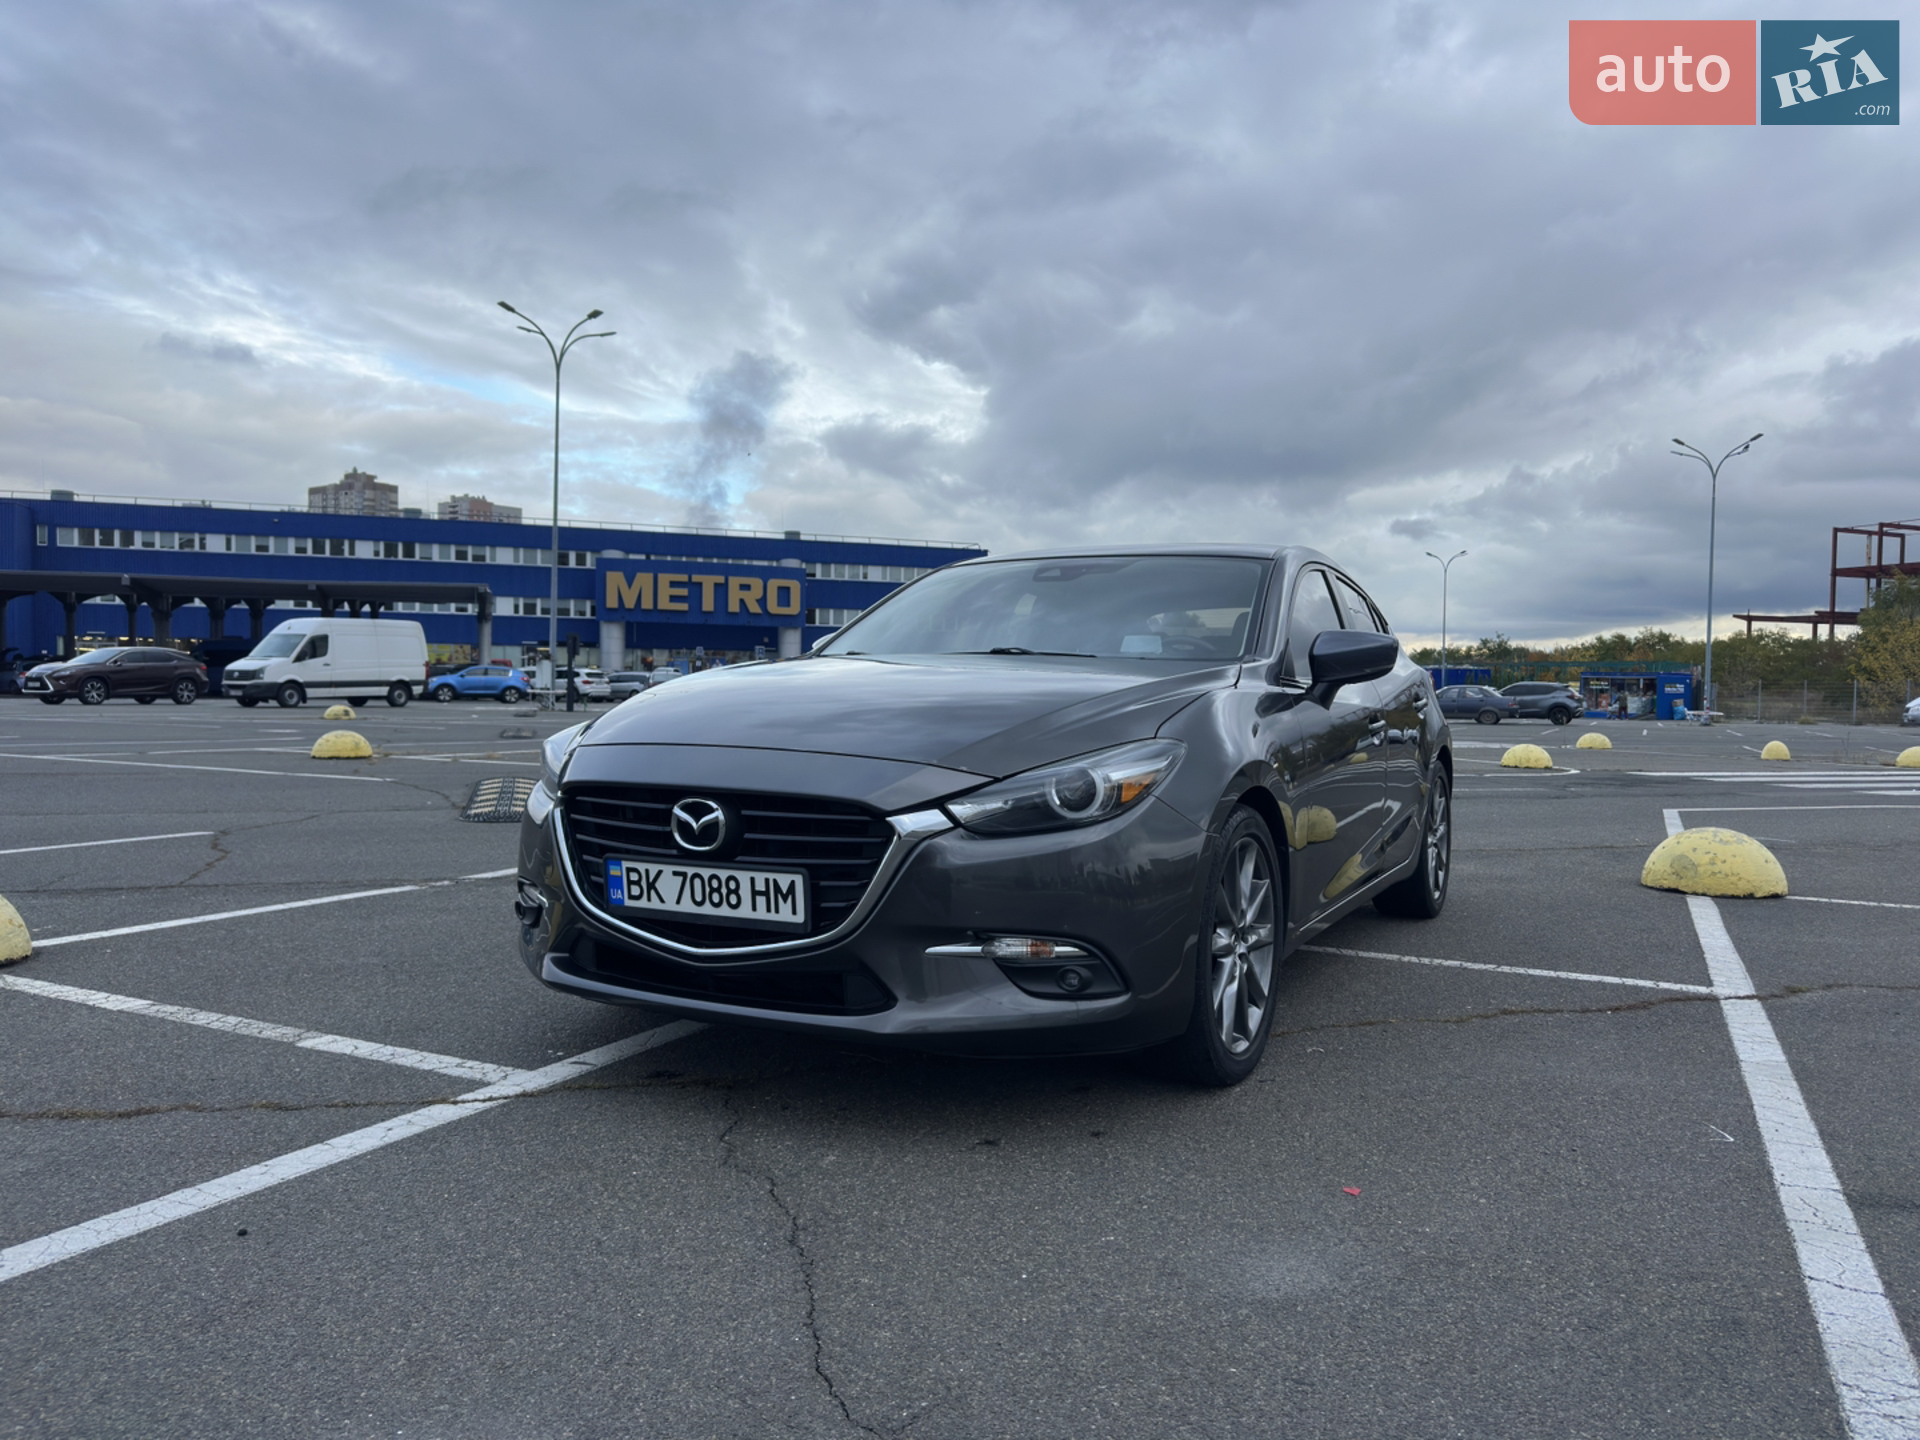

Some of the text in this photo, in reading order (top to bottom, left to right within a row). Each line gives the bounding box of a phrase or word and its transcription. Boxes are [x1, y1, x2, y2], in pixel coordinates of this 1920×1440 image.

[605, 571, 801, 615] METRO
[610, 888, 624, 900] UA
[625, 866, 798, 916] BK 7088 HM
